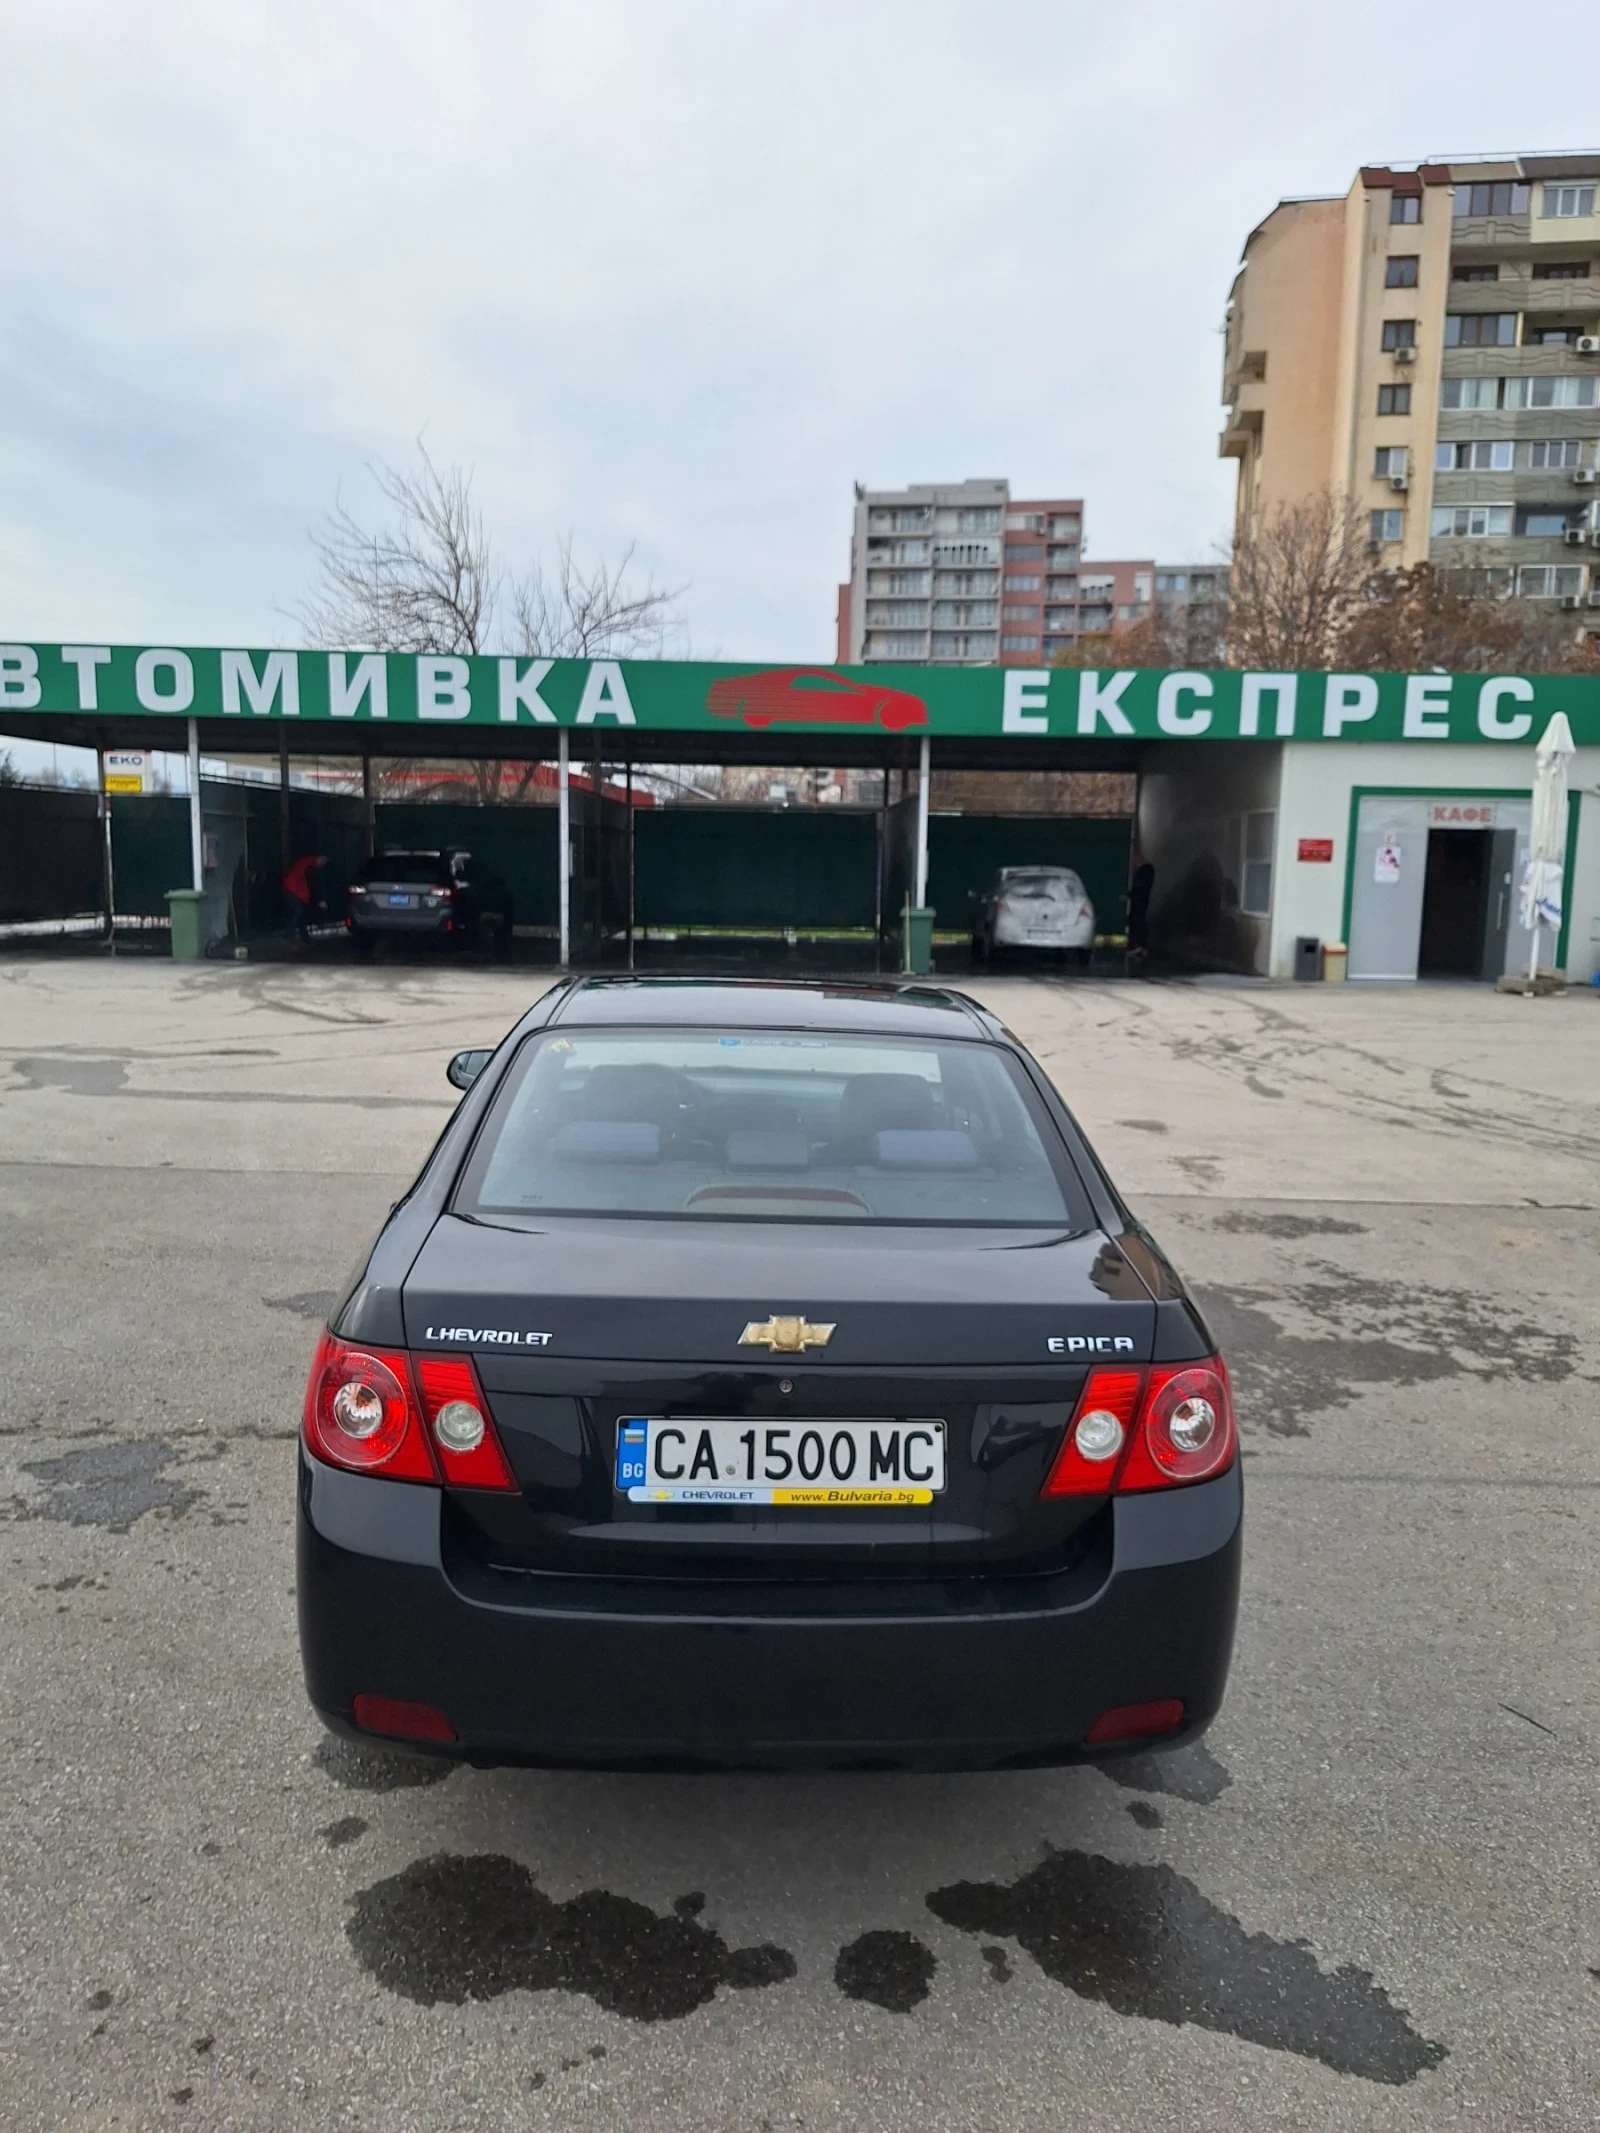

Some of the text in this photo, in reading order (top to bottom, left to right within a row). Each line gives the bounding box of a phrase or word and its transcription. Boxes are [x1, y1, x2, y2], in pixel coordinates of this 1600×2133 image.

[1002, 669, 1535, 741] ЕКСПРЕС
[109, 756, 143, 765] EKO
[1433, 806, 1493, 822] КАФЕ
[1047, 1336, 1135, 1353] EPICA
[653, 1428, 935, 1482] CA 1500 MC
[622, 1462, 644, 1479] BG
[682, 1490, 755, 1500] CHEVROLET
[790, 1490, 915, 1504] www.Bulvaria.bg
